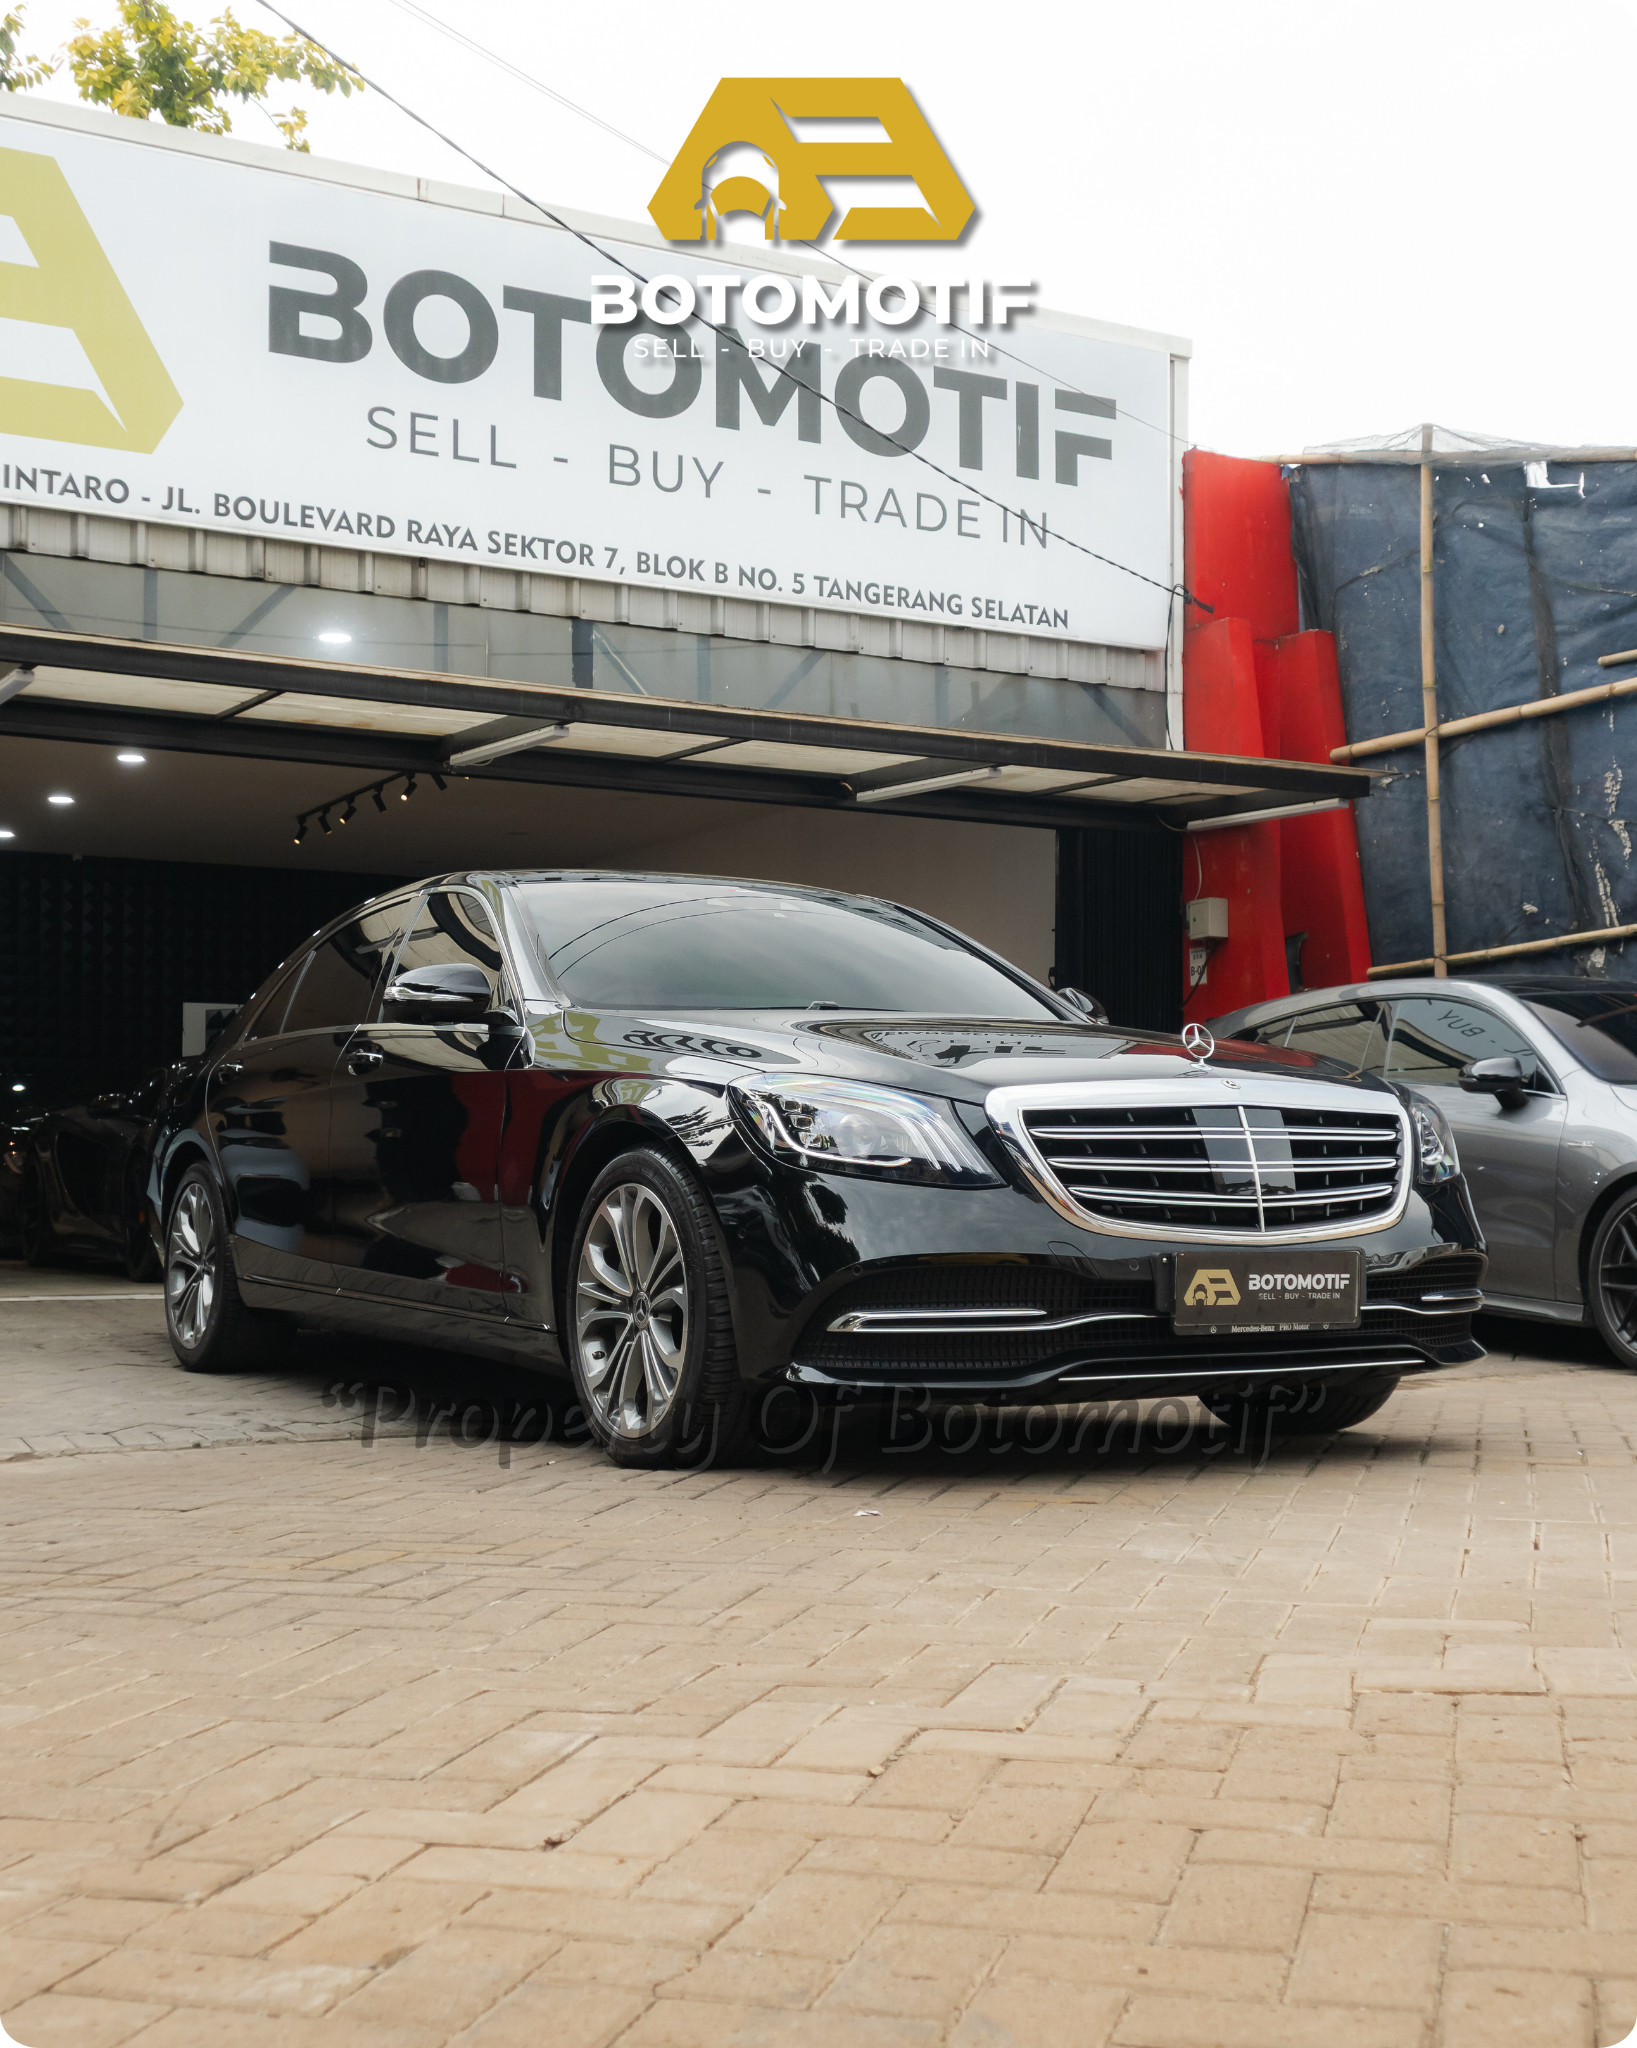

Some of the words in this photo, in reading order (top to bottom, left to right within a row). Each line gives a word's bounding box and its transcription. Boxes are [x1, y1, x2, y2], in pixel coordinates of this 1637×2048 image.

[268, 241, 1117, 487] BOTOMOTIF
[366, 406, 517, 469] SELL
[608, 444, 724, 499] BUY
[804, 475, 982, 539] TRADE
[1002, 509, 1048, 549] IN
[161, 485, 200, 515] JL.
[213, 493, 396, 538] BOULEVARD
[406, 519, 478, 551] RAYA
[487, 530, 595, 567] SEKTOR
[603, 547, 626, 575] 7,
[636, 551, 705, 582] BLOK
[714, 562, 729, 584] B
[738, 564, 783, 592] NO.
[791, 572, 805, 595] 5
[813, 575, 963, 616] TANGERANG
[971, 597, 1069, 630] SELATAN
[1249, 1273, 1351, 1290] BOTOMOTIF
[1284, 1292, 1300, 1300] BUY
[1307, 1292, 1331, 1300] TRADE
[1231, 1325, 1275, 1333] Mercedes-Benz
